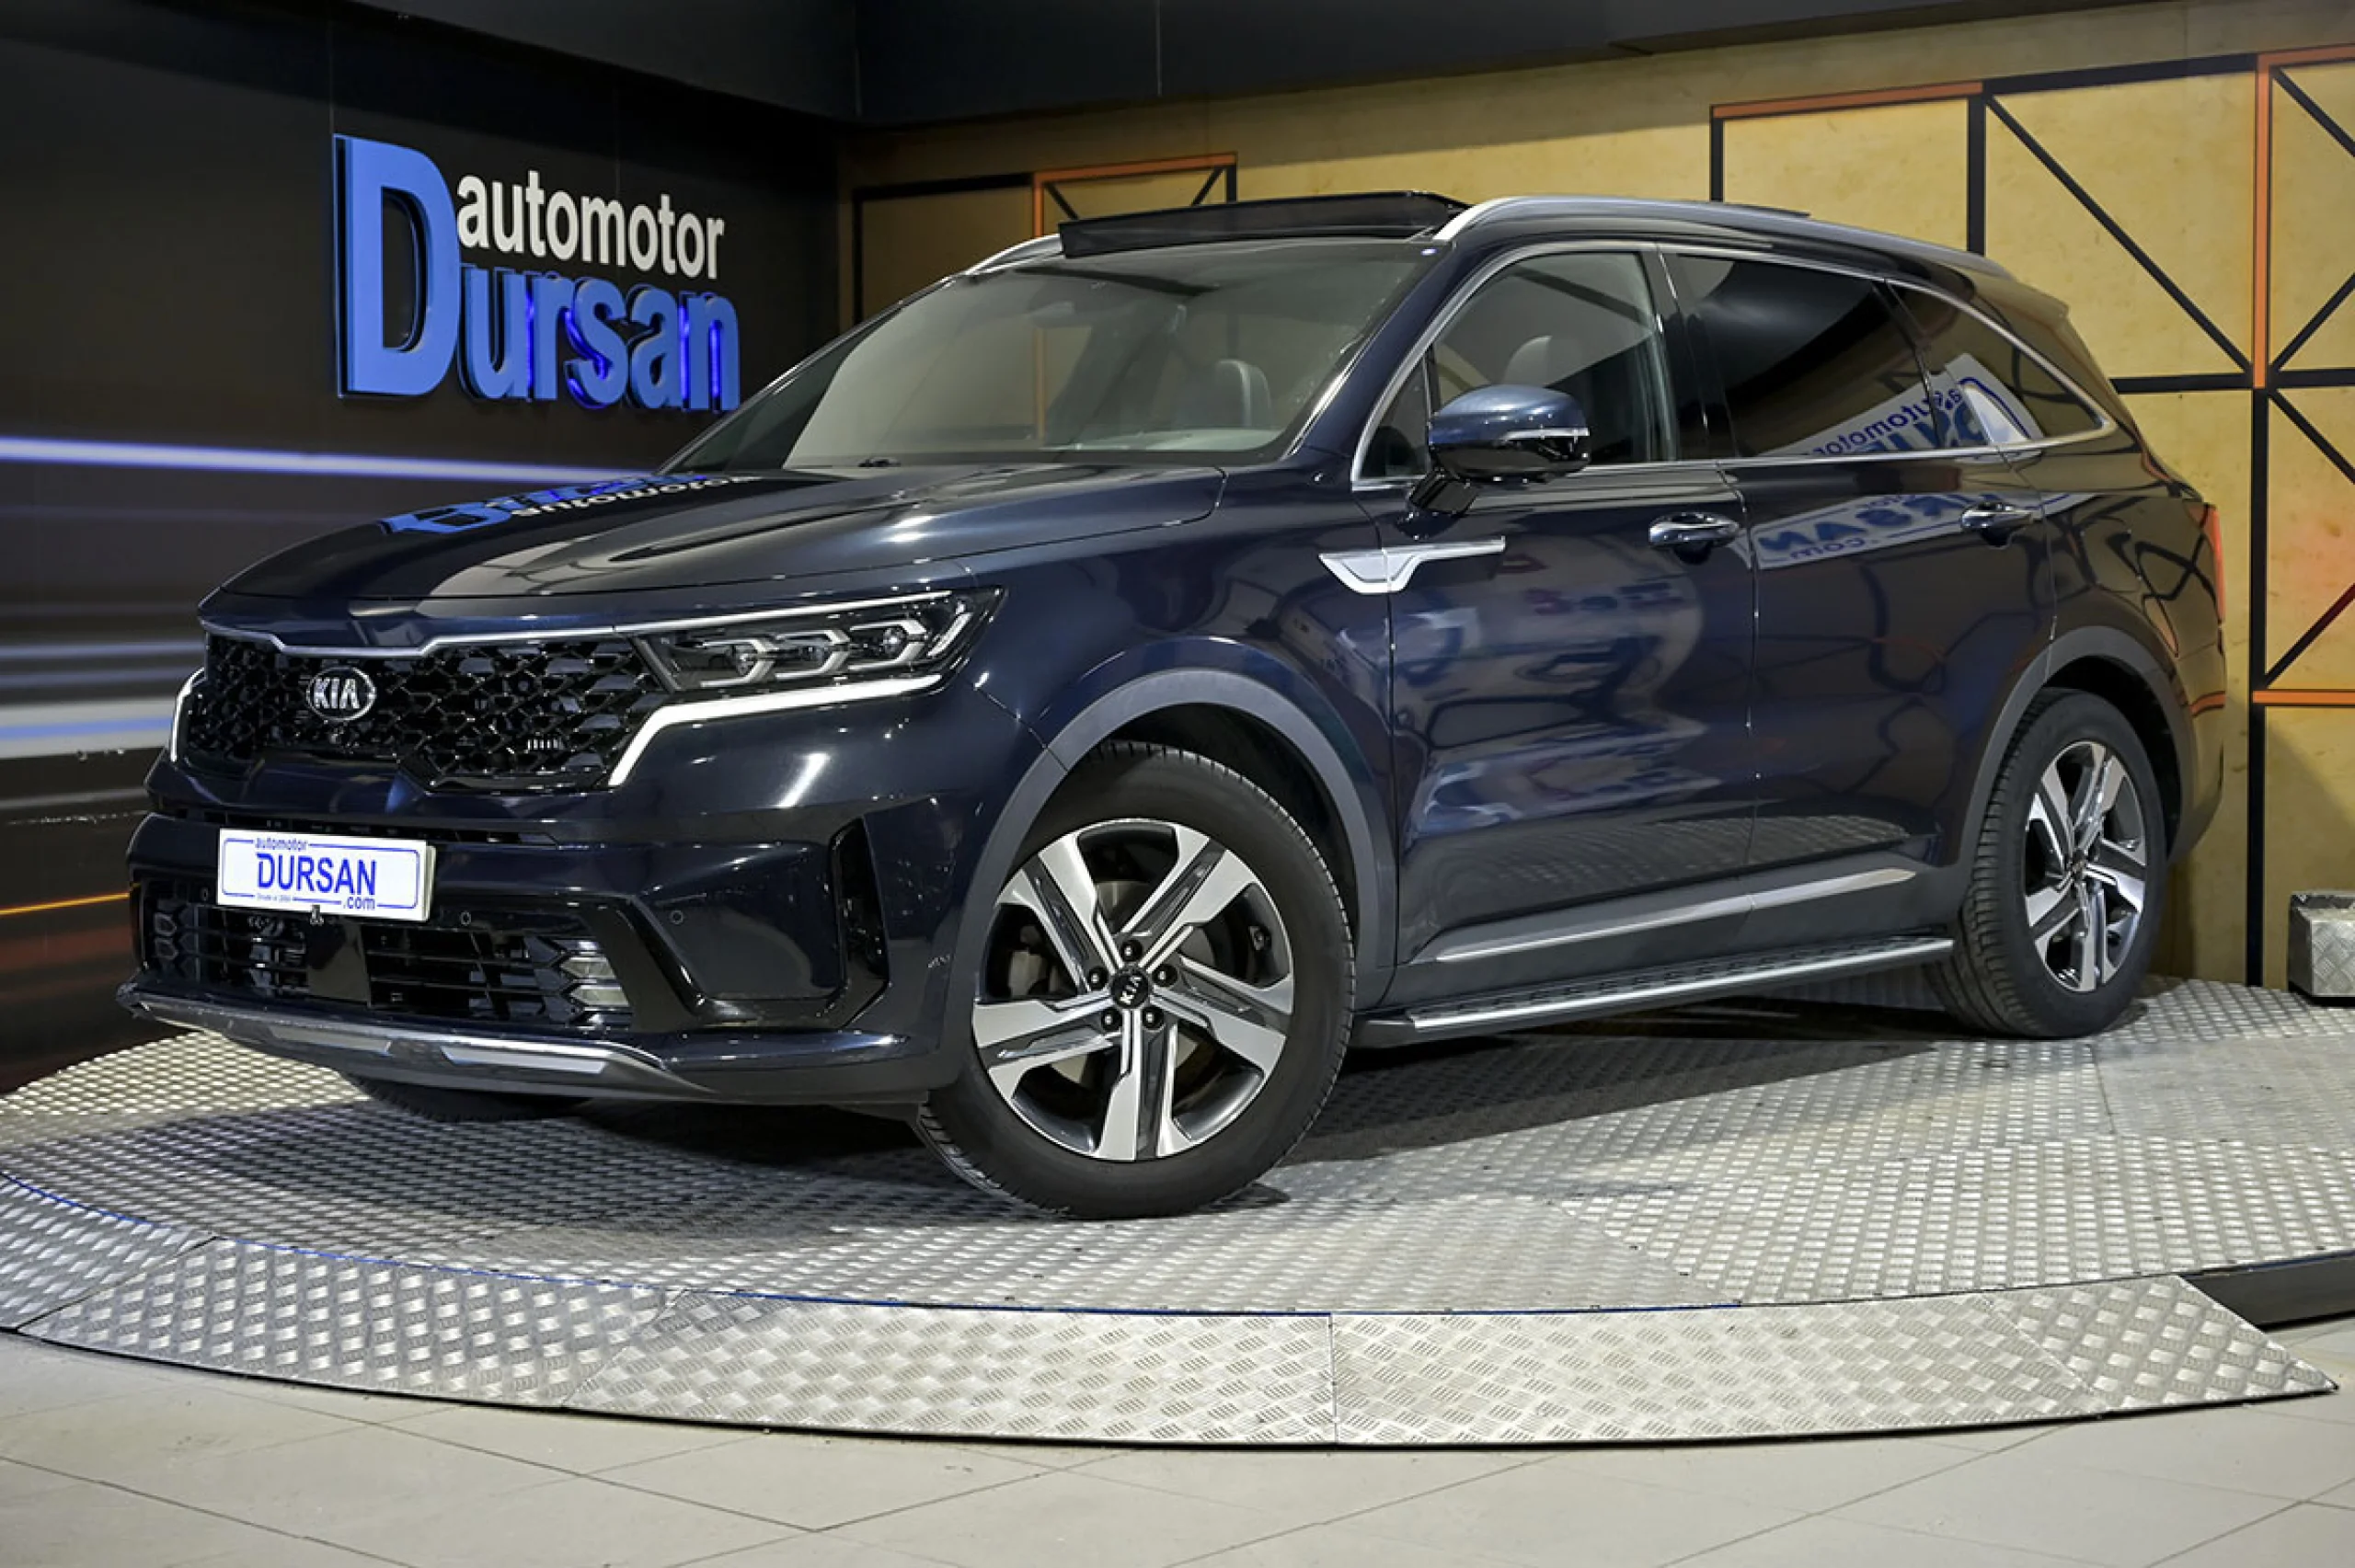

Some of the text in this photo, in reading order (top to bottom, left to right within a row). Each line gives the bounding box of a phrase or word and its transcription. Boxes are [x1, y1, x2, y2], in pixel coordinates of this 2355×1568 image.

[457, 169, 725, 280] automotor
[333, 133, 741, 412] Dursan
[313, 678, 360, 709] KIA
[254, 836, 309, 852] automotor
[256, 852, 377, 896] DURSAN
[342, 895, 376, 910] .com
